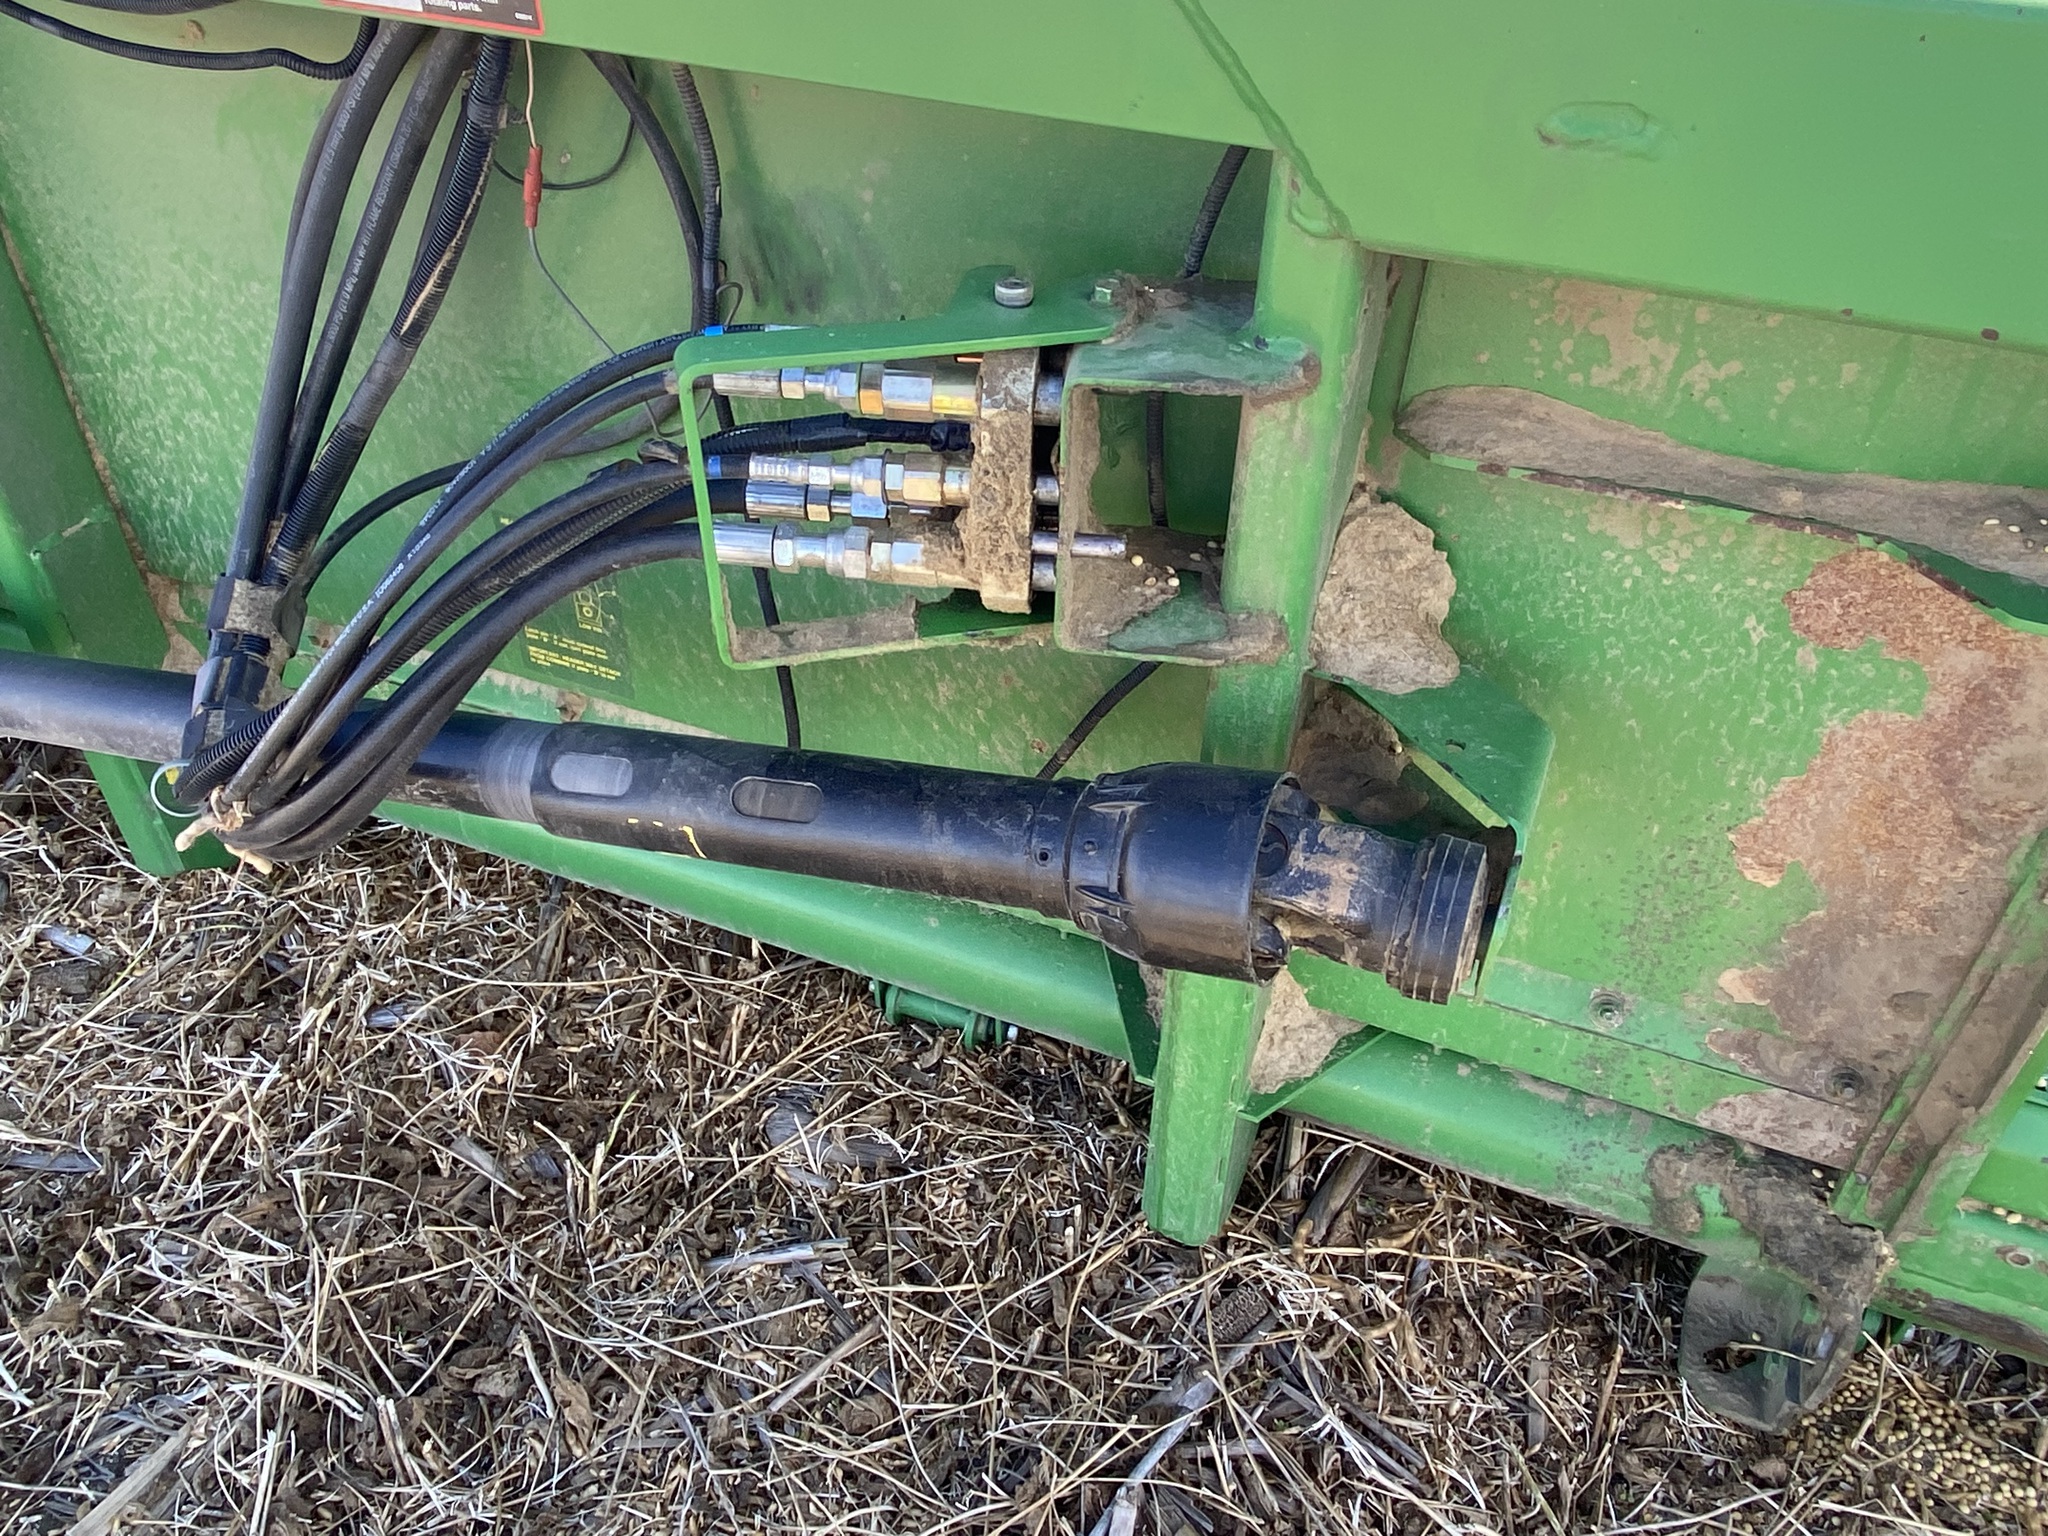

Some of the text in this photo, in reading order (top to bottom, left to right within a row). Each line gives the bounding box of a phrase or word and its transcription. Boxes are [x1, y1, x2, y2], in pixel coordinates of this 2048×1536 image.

[458, 1, 482, 12] parts.
[338, 109, 351, 133] 3000
[346, 95, 357, 114] PSI
[366, 203, 382, 232] FLAME
[375, 165, 396, 208] RESISTANT
